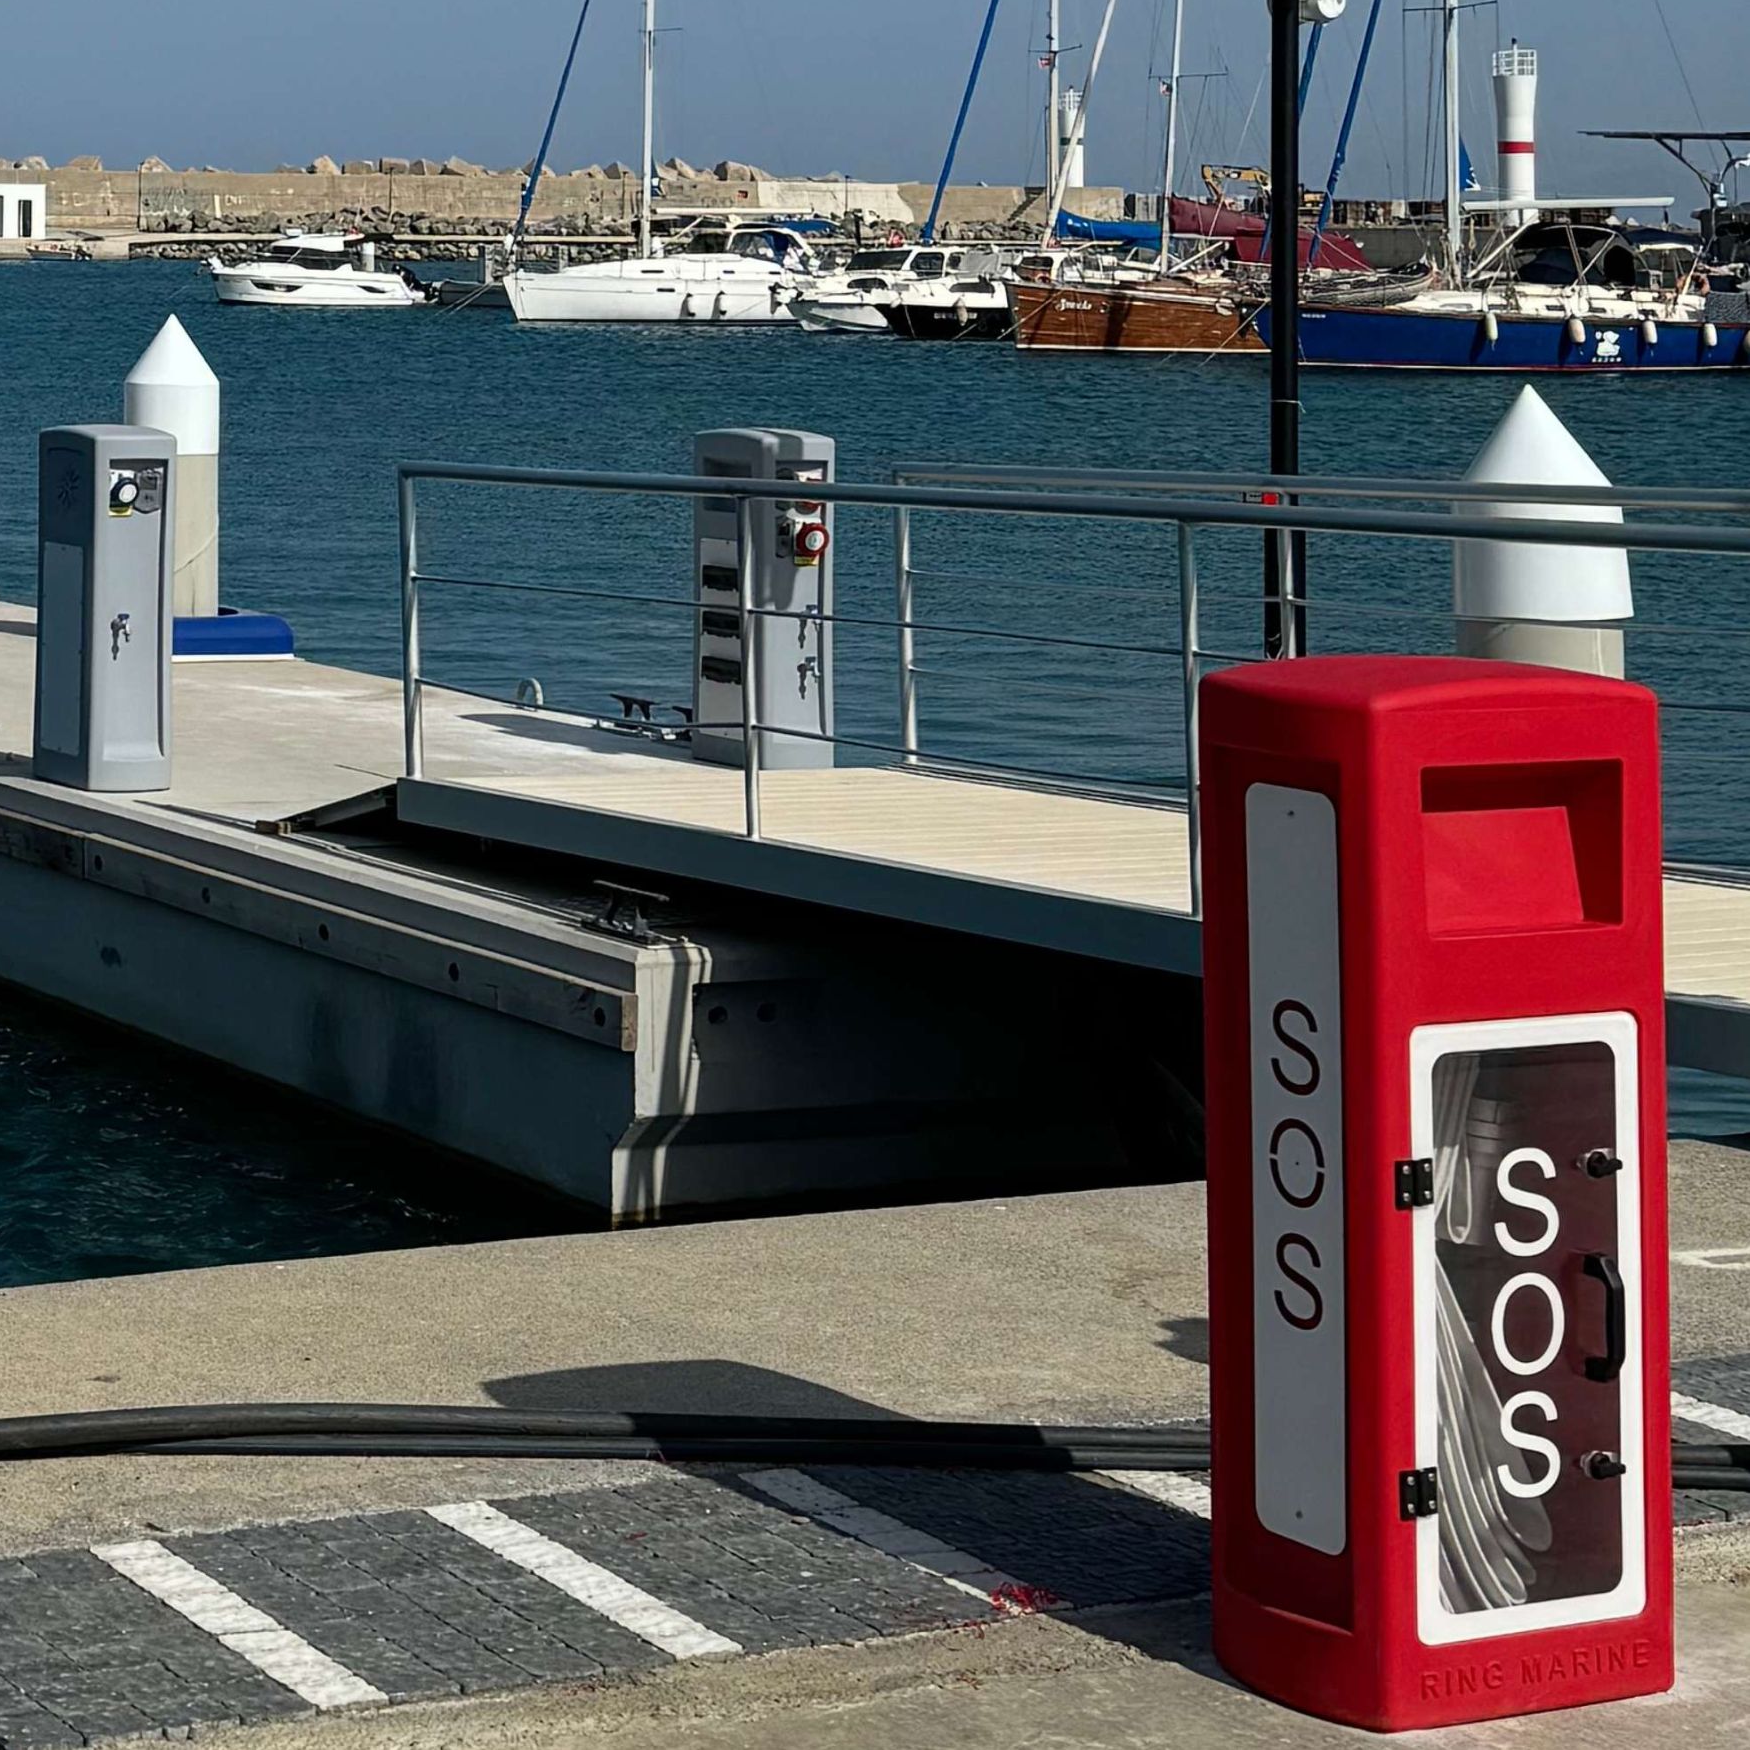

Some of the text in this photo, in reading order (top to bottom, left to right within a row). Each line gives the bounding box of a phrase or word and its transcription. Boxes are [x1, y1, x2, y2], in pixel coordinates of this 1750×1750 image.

[1269, 999, 1325, 1331] SOS
[1491, 1147, 1565, 1499] SOS
[1419, 1638, 1651, 1701] RING MARINE
